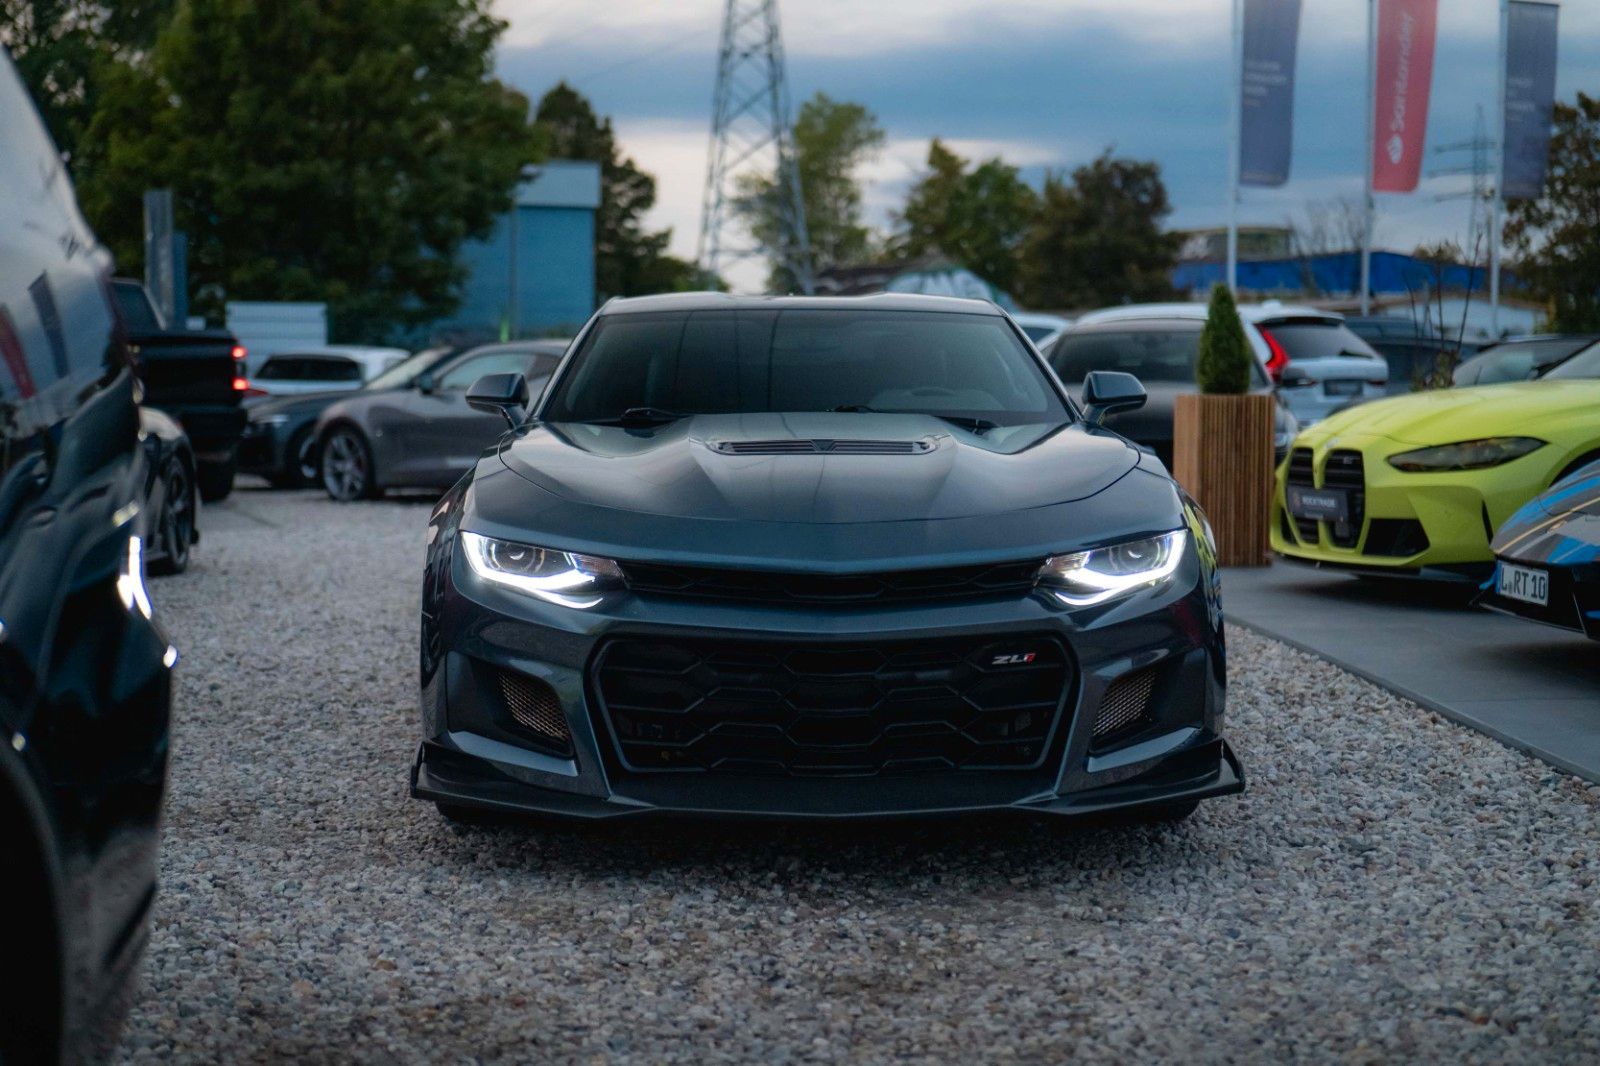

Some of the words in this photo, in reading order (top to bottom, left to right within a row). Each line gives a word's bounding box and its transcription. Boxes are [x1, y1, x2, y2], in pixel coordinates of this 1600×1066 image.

[1501, 565, 1508, 591] L
[1513, 570, 1530, 597] RT
[1531, 575, 1546, 600] 10
[992, 652, 1036, 665] ZL1
